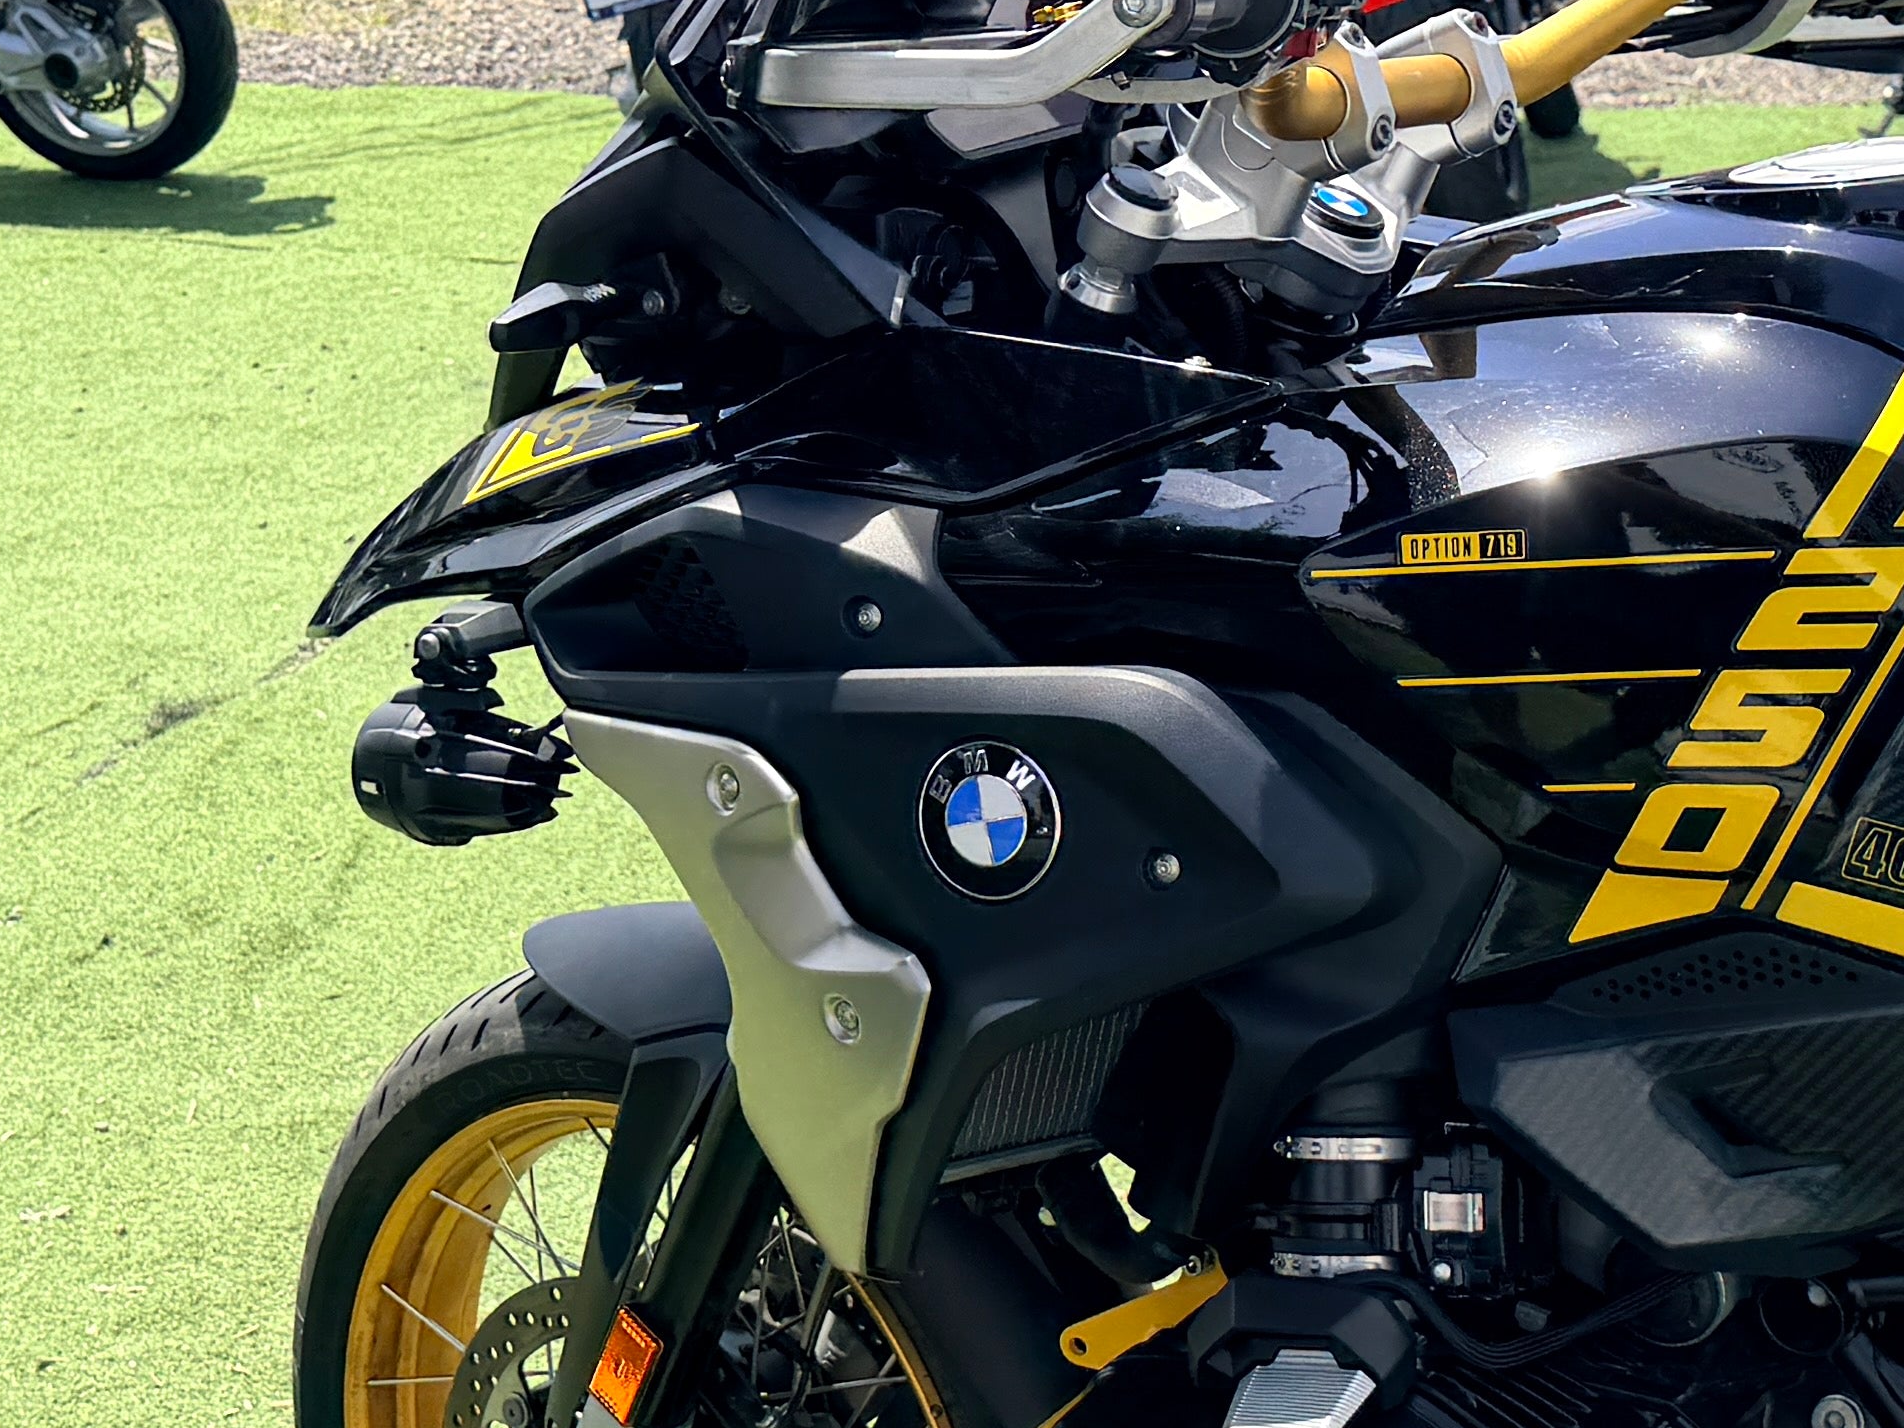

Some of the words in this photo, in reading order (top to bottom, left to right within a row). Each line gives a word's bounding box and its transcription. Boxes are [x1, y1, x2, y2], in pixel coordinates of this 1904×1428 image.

[1409, 535, 1472, 561] OPTION
[1485, 532, 1518, 558] 719
[928, 747, 1036, 805] BMW
